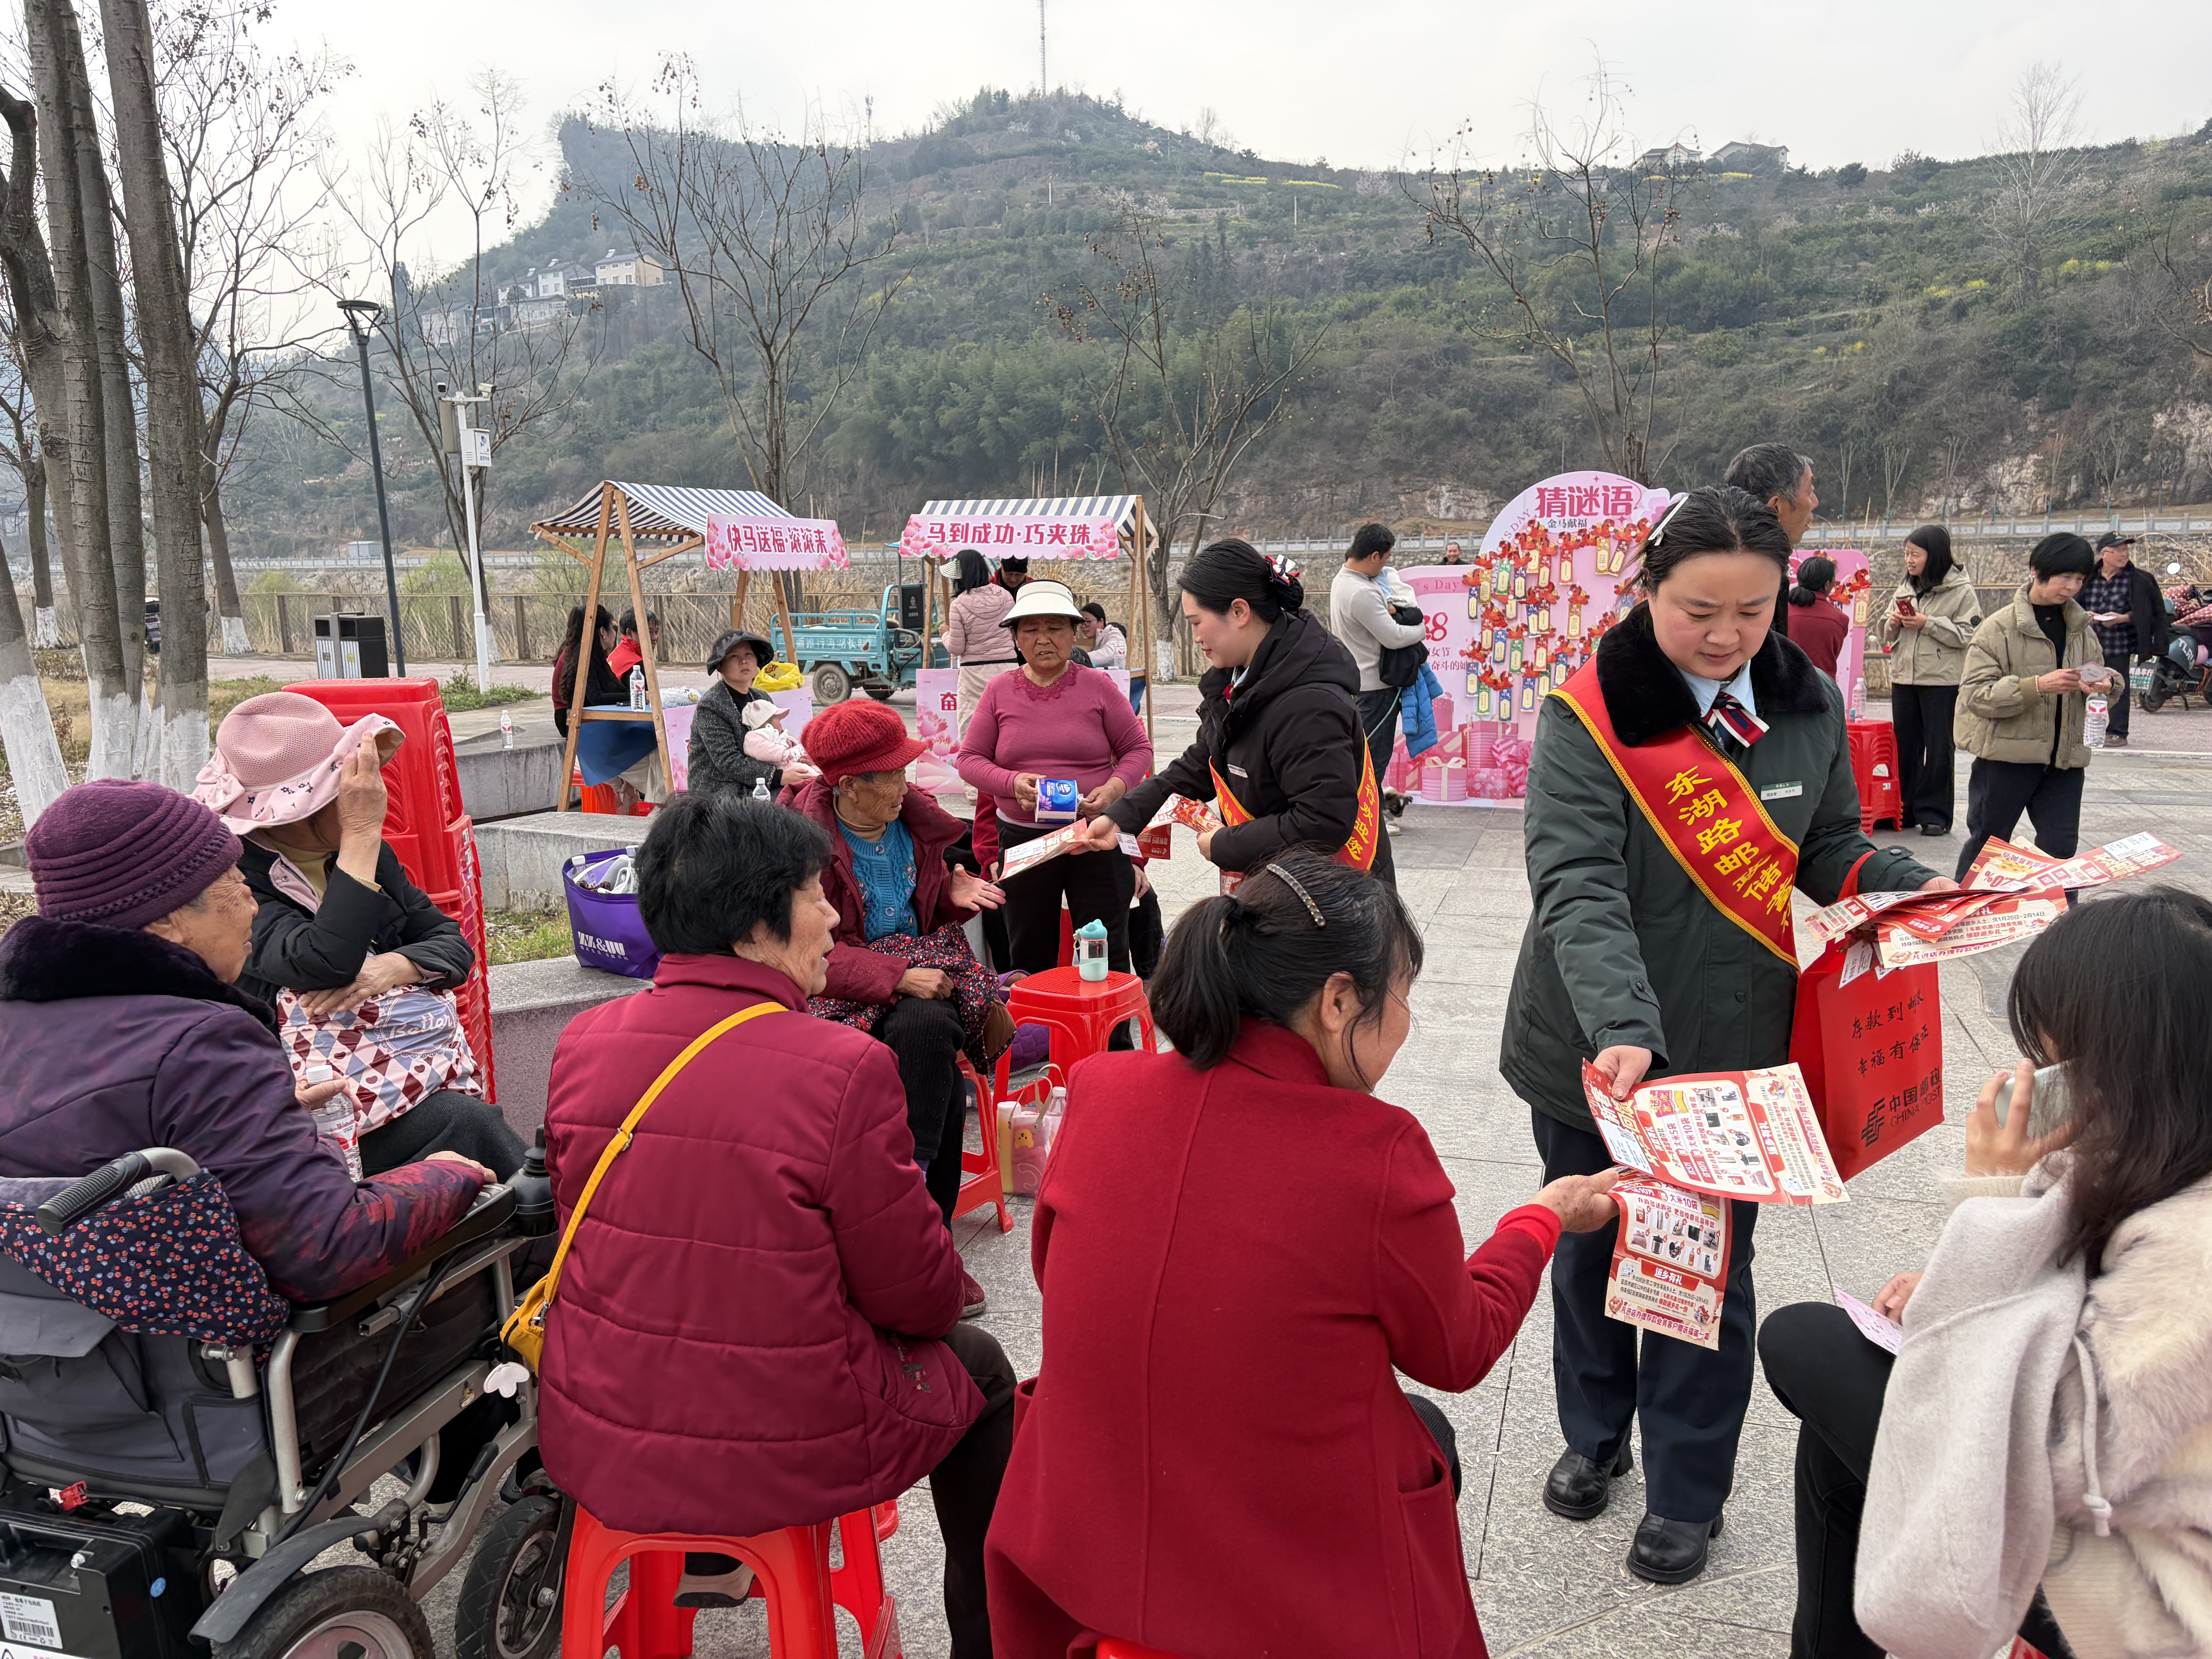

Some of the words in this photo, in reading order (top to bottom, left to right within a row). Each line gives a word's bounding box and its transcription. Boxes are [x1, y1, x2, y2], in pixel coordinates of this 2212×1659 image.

[1535, 485, 1633, 518] 猜谜语
[1511, 509, 1531, 532] DAY
[1547, 518, 1587, 528] 金马献福
[727, 524, 828, 554] 快马送福·滚滚来
[927, 522, 1092, 545] 马到成功·巧夹珠
[1435, 579, 1459, 592] Day
[389, 1012, 452, 1039] Better
[1889, 1067, 1940, 1113] 中国邮政
[1667, 1122, 1681, 1147] 大米5袋
[1681, 1117, 1697, 1147] 大米10袋
[1759, 1121, 1779, 1155] 返乡有礼
[1669, 1194, 1698, 1210] 大米10袋
[1654, 1267, 1682, 1286] 返乡有礼
